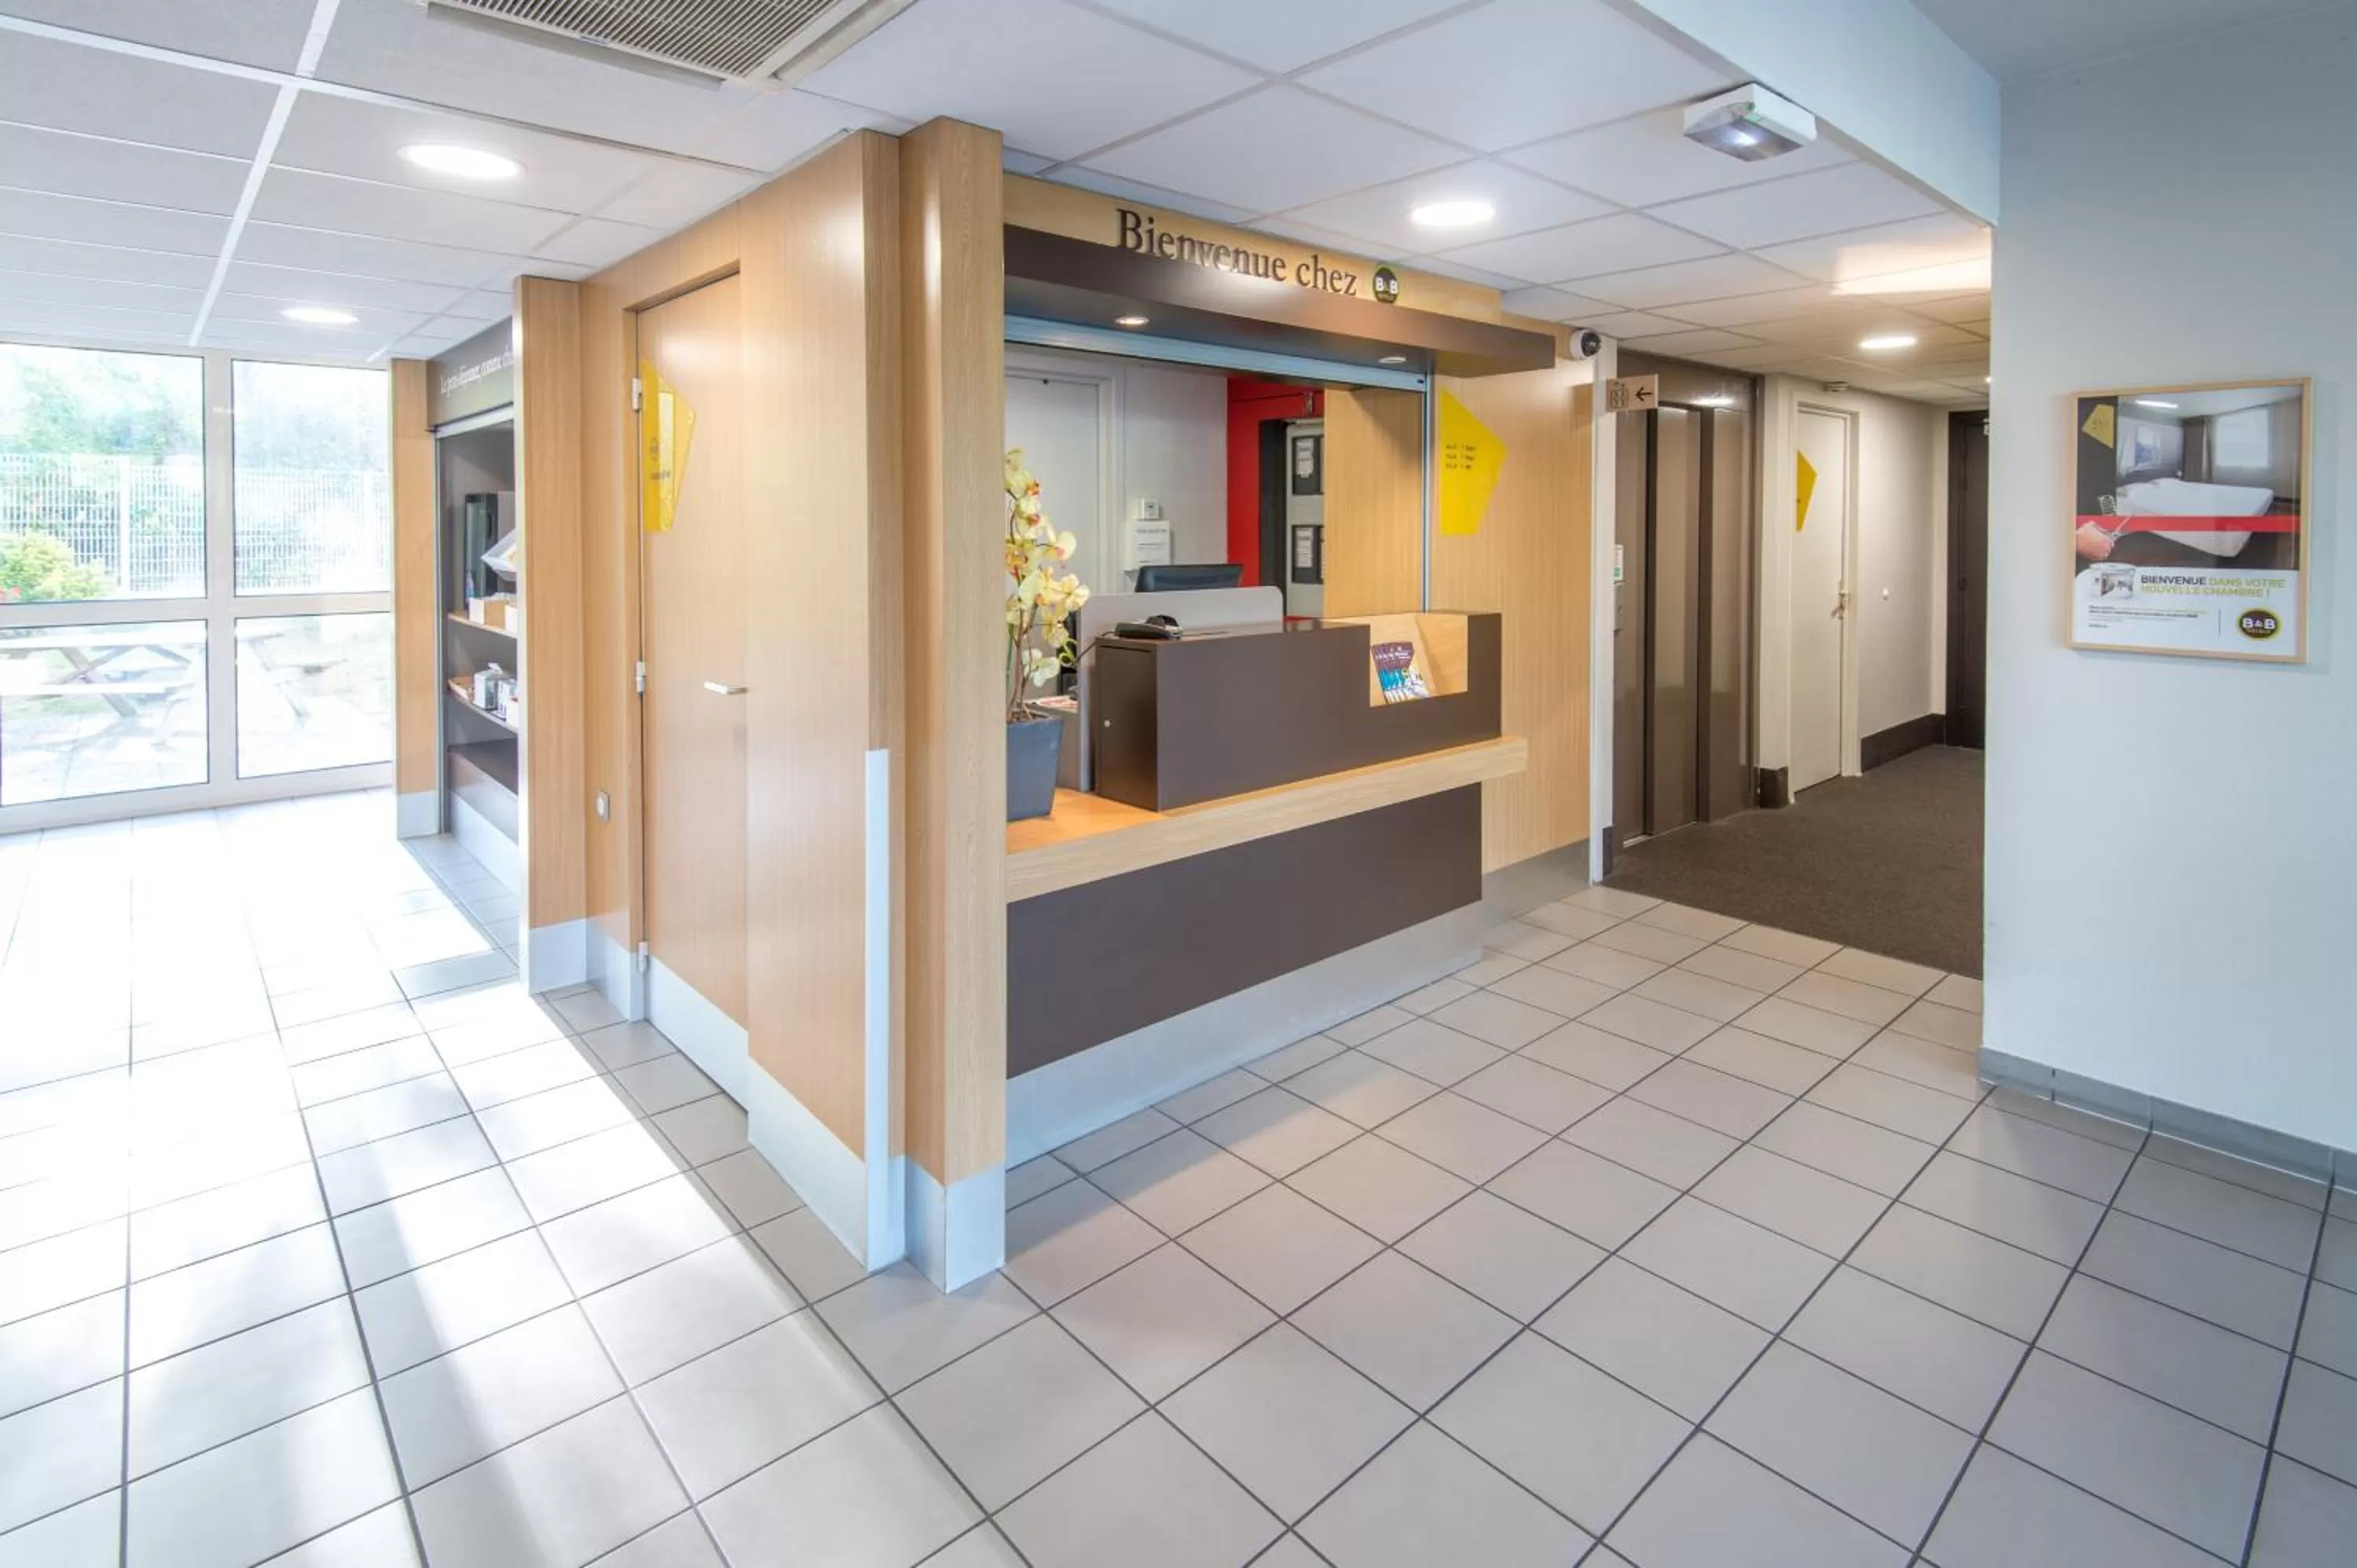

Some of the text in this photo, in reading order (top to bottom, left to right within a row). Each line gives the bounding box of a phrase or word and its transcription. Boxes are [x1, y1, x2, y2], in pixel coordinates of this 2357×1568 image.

[1116, 207, 1358, 297] Bienvenue chez
[2140, 574, 2286, 588] BIENVENUE DANS VOTRE
[2141, 584, 2201, 595] NOUVELLE
[2203, 588, 2264, 598] CHAMBRE
